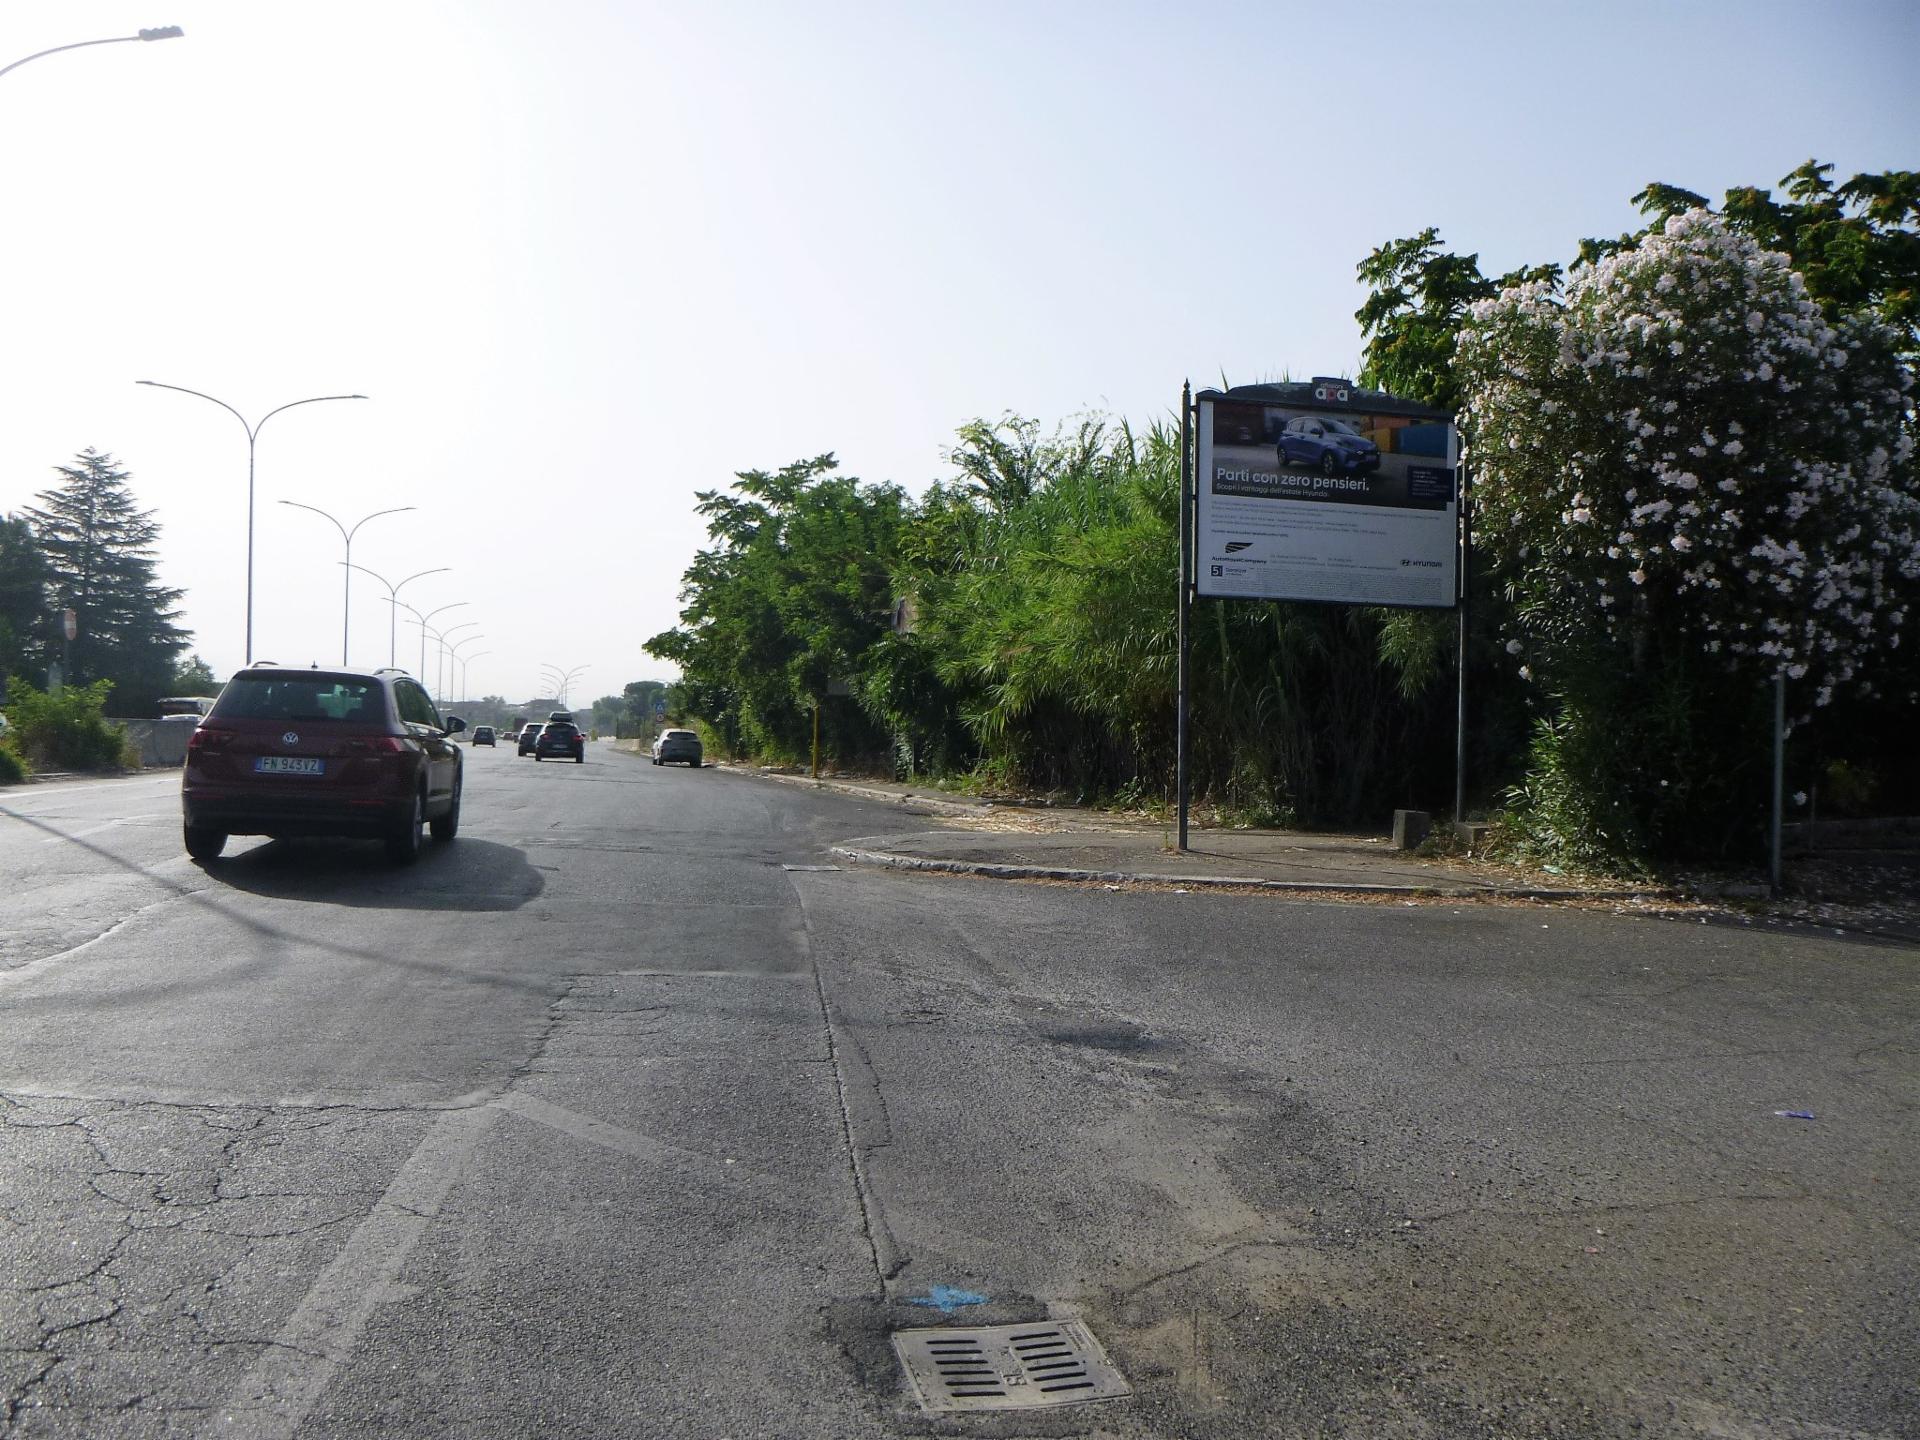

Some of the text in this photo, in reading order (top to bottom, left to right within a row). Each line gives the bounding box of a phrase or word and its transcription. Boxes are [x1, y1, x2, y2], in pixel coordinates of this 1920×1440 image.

[1216, 467, 1370, 491] Parti con zero pensieri.
